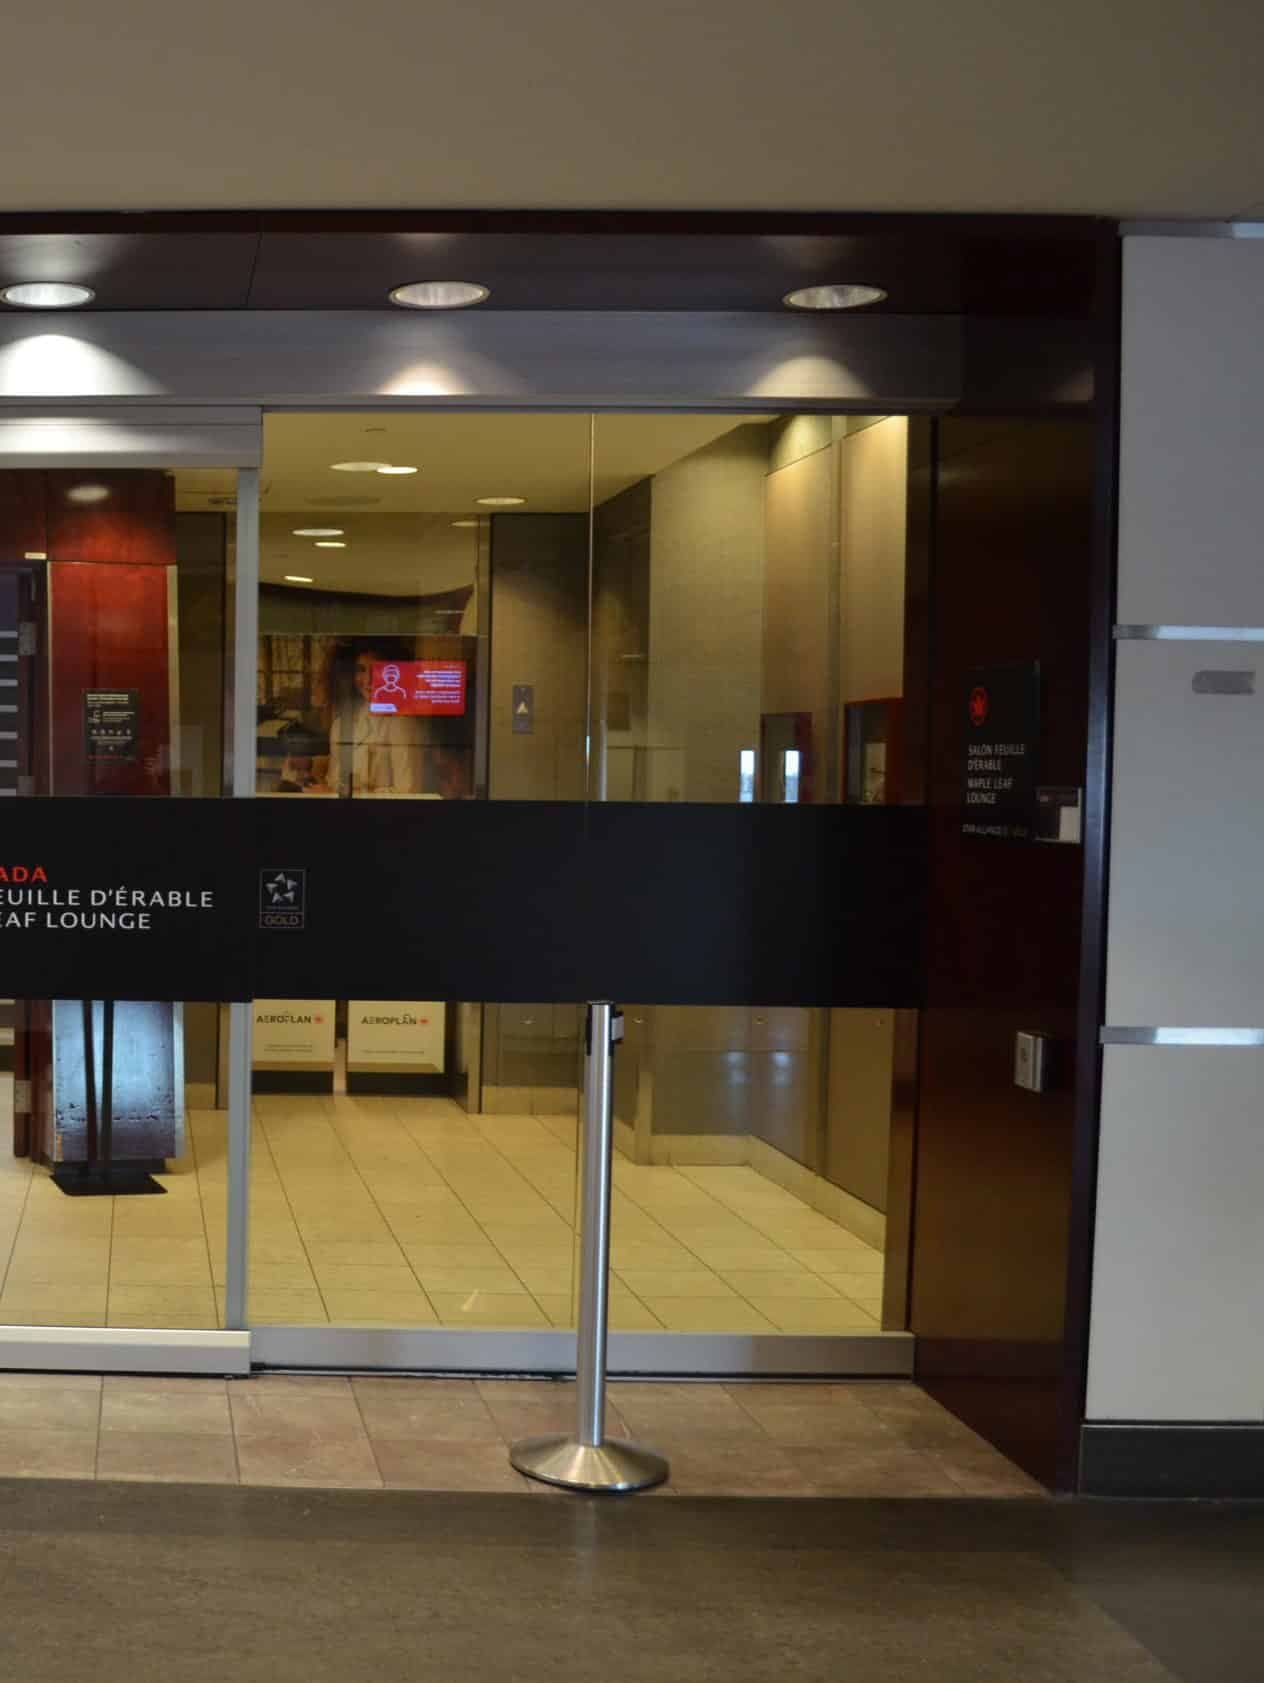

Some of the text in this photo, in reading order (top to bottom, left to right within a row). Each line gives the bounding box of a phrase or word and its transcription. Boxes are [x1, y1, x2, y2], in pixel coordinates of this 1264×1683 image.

[90, 886, 213, 908] D'ÉRABLE
[46, 911, 152, 930] LOUNGE
[264, 914, 299, 926] GOLD
[256, 1015, 312, 1025] AEROPLAN
[361, 1016, 417, 1025] AEROPLAN
